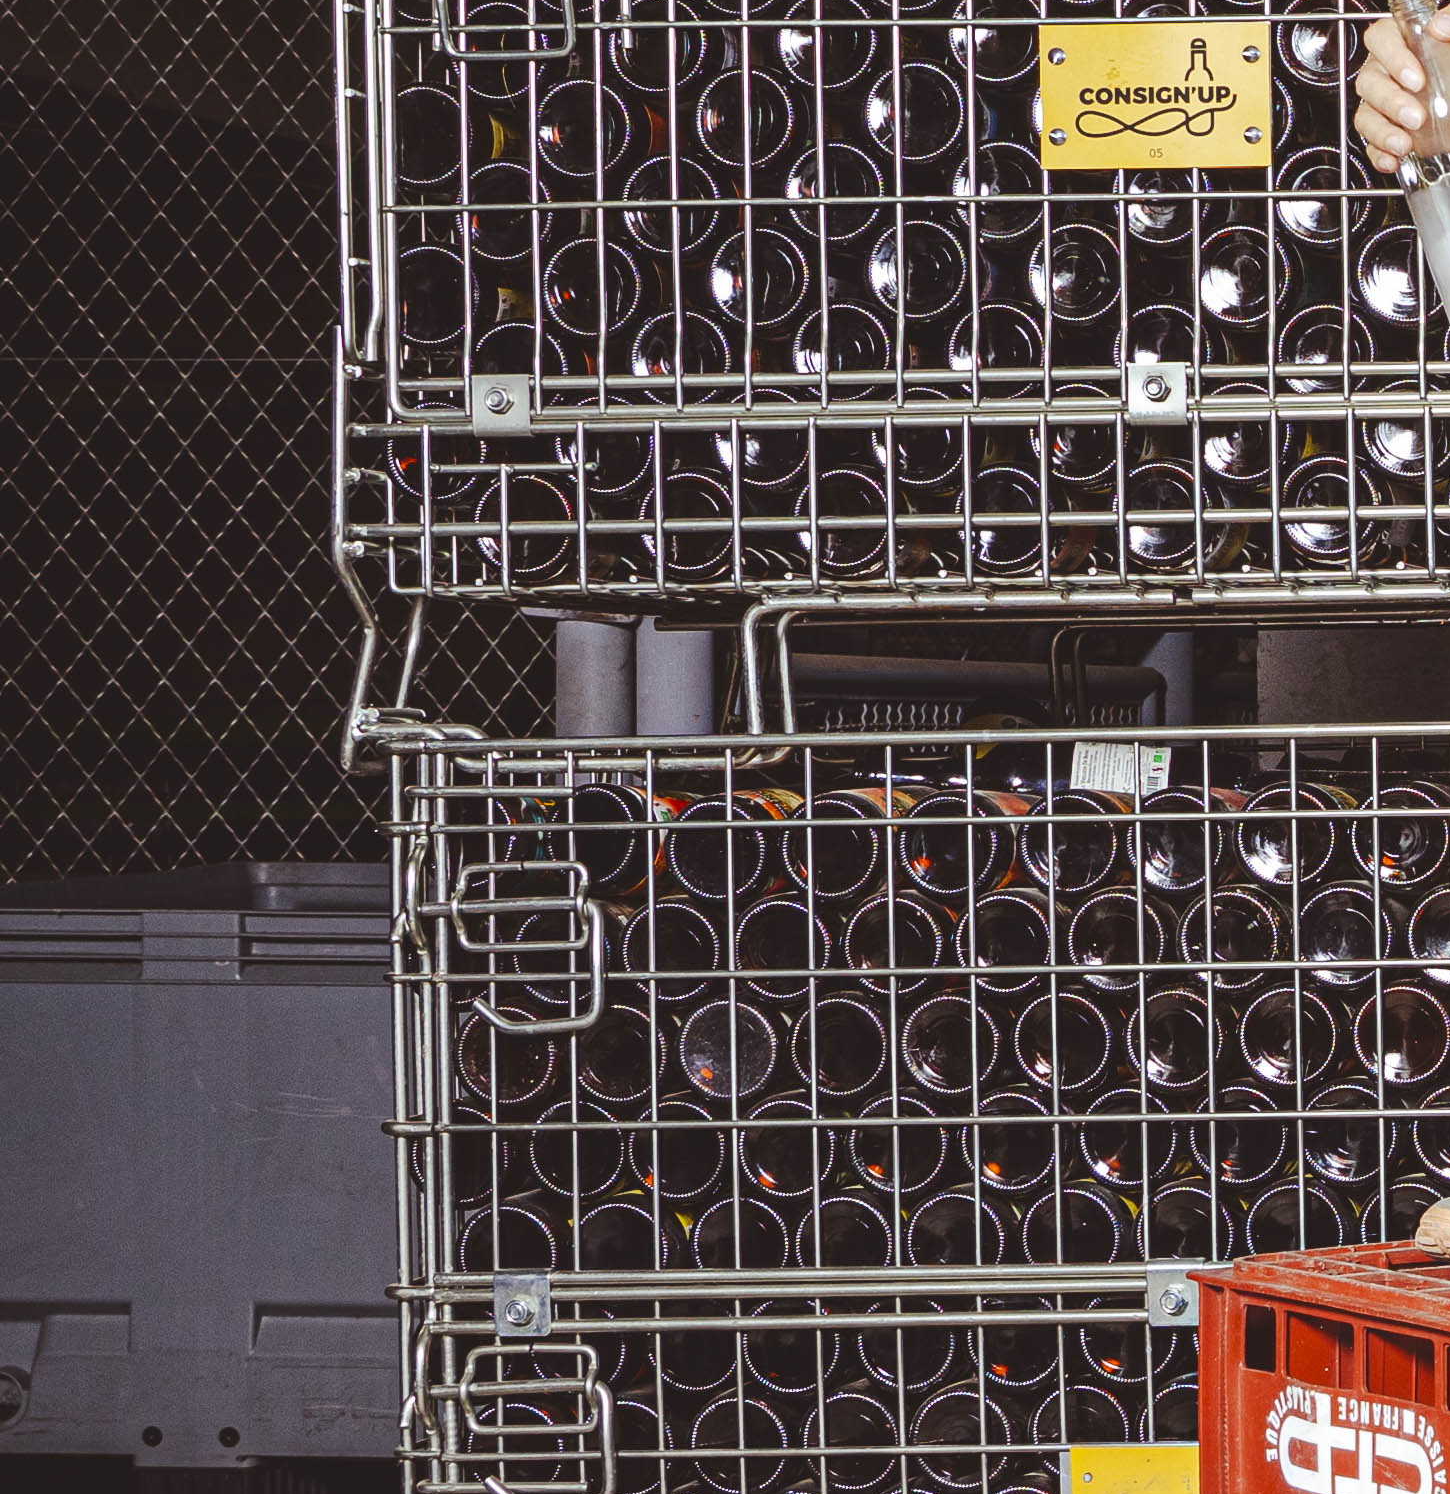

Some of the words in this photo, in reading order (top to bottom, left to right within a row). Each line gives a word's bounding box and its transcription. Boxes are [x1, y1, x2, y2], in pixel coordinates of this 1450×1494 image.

[1079, 86, 1232, 105] CONSIGN'UP
[1149, 148, 1164, 158] 05
[1265, 1385, 1312, 1462] PLASTIQUE
[1336, 1396, 1400, 1430] FRANCE
